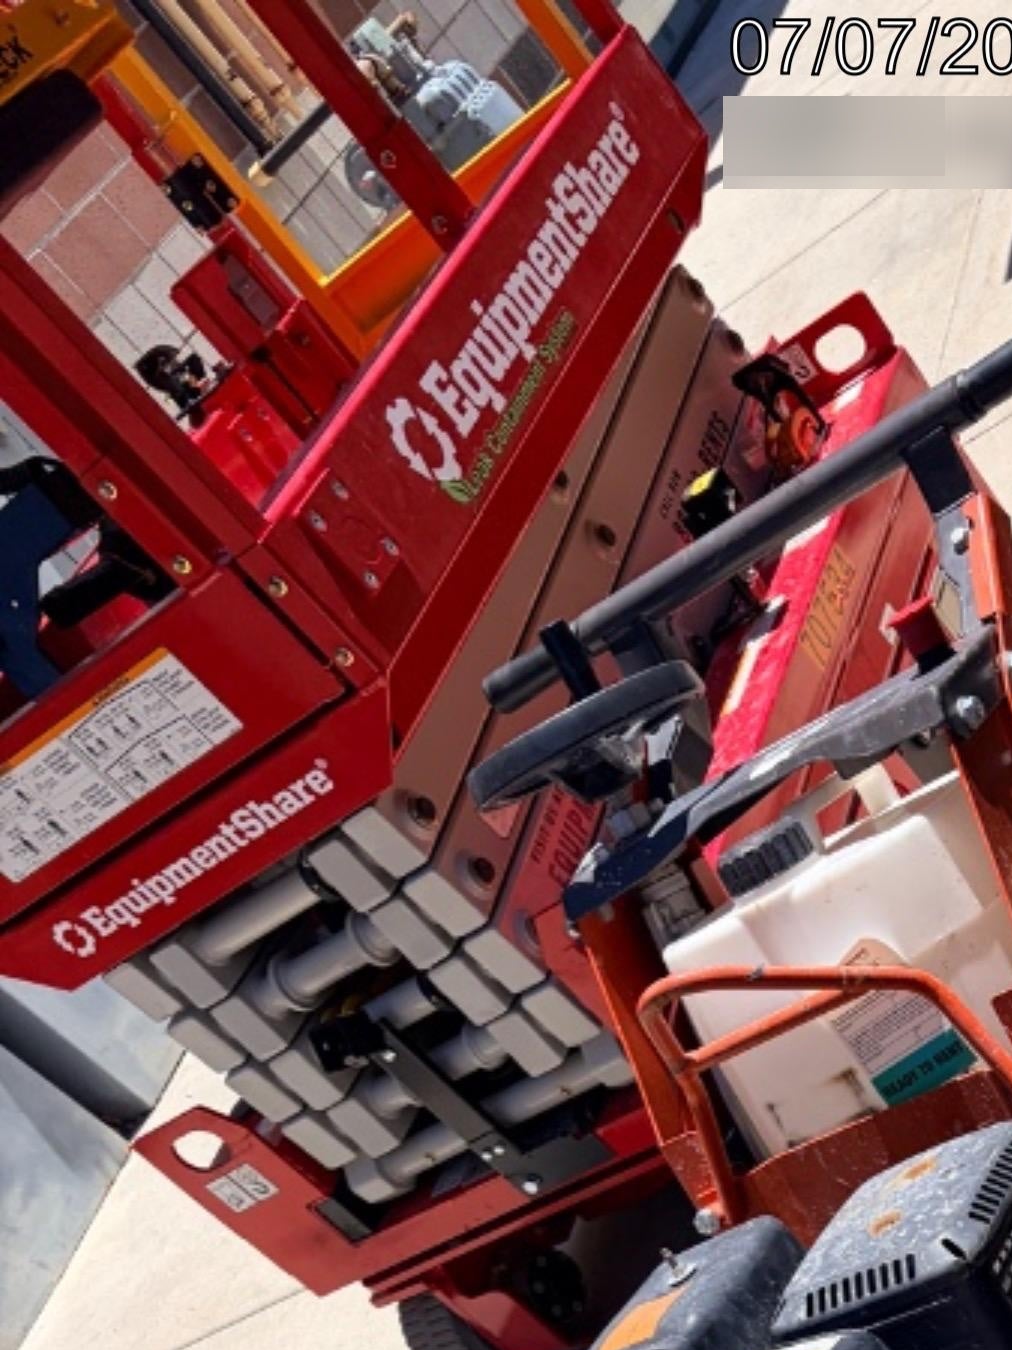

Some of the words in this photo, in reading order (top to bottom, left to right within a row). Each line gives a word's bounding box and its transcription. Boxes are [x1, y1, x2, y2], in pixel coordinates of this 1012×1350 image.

[419, 116, 640, 438] EquipmentShare
[80, 767, 335, 939] EquipmentShare
[880, 1070, 919, 1097] READY
[917, 1060, 934, 1076] TO
[932, 1039, 965, 1064] RENT
